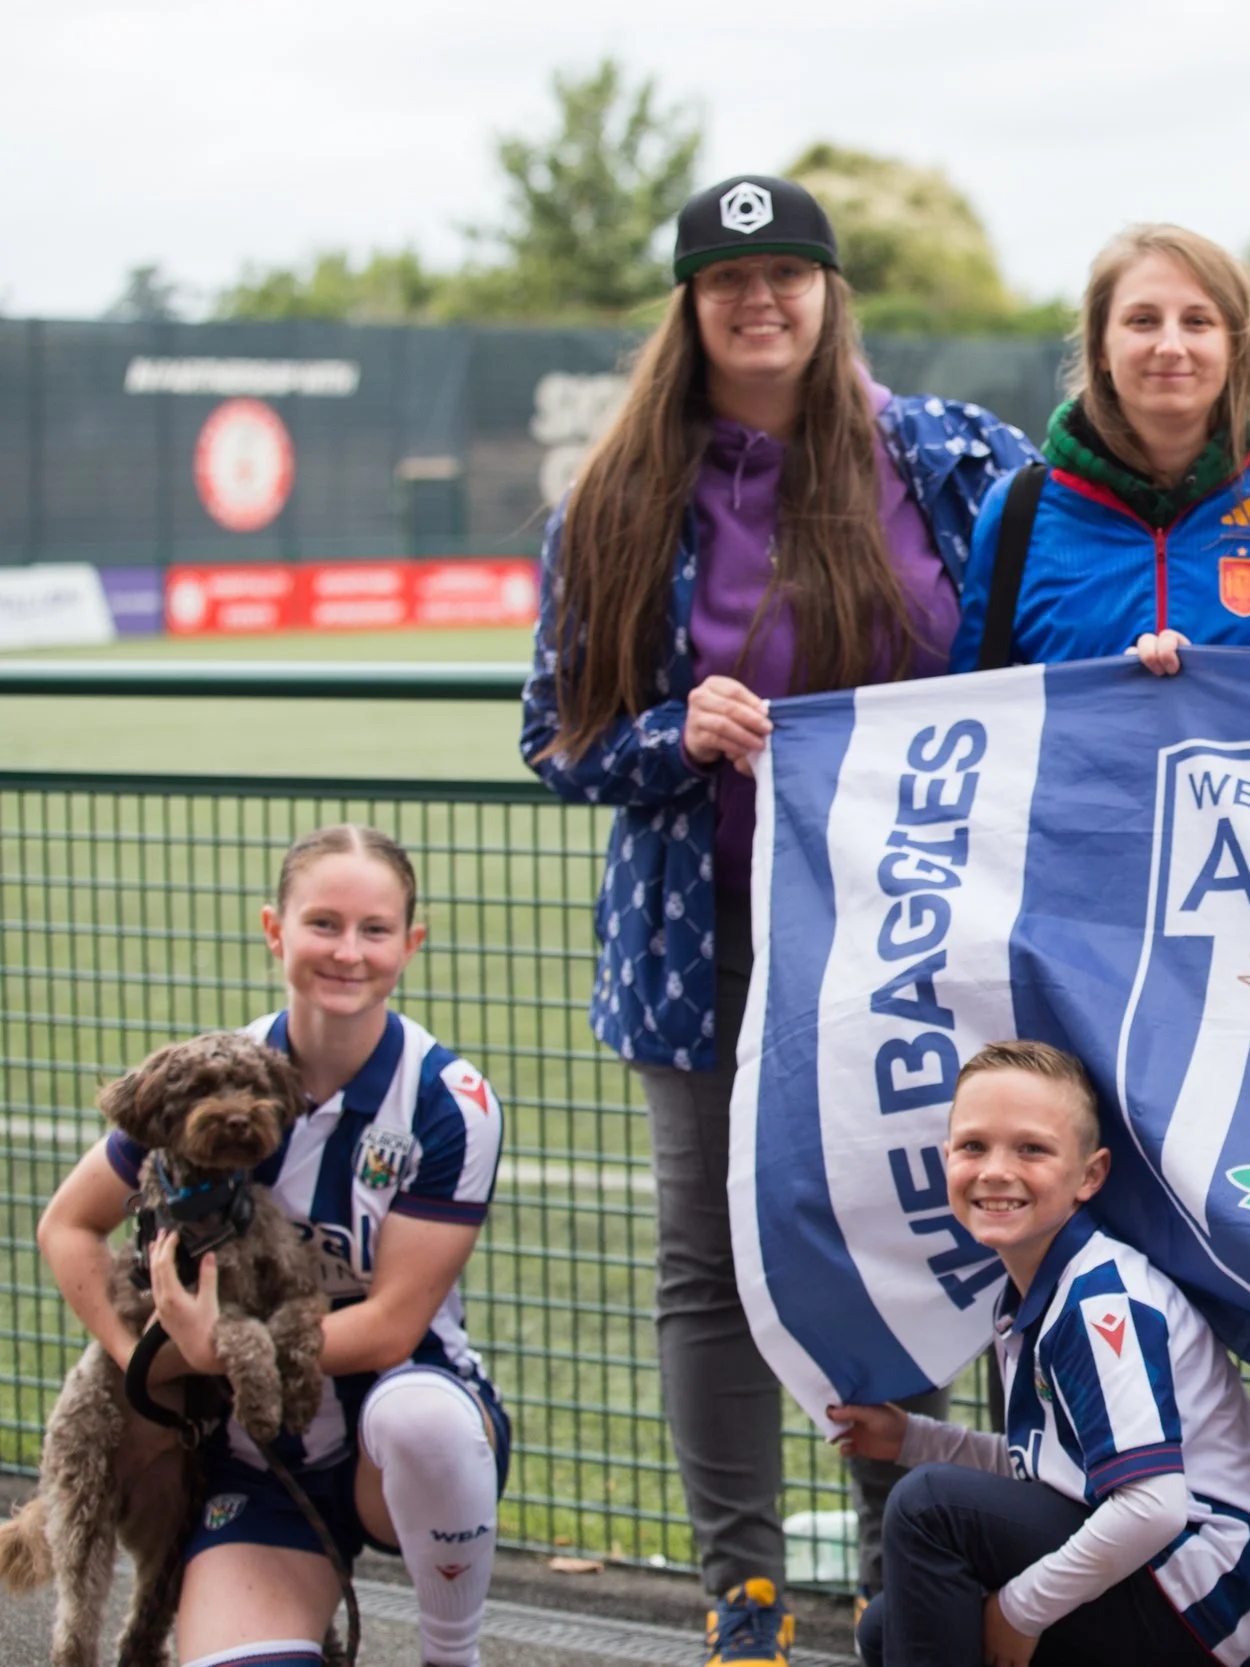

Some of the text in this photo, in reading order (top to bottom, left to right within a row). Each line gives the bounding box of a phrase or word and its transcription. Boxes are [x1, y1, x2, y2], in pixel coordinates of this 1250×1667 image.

[870, 718, 1009, 1312] THE BAGGIES
[430, 1524, 489, 1544] WBA
